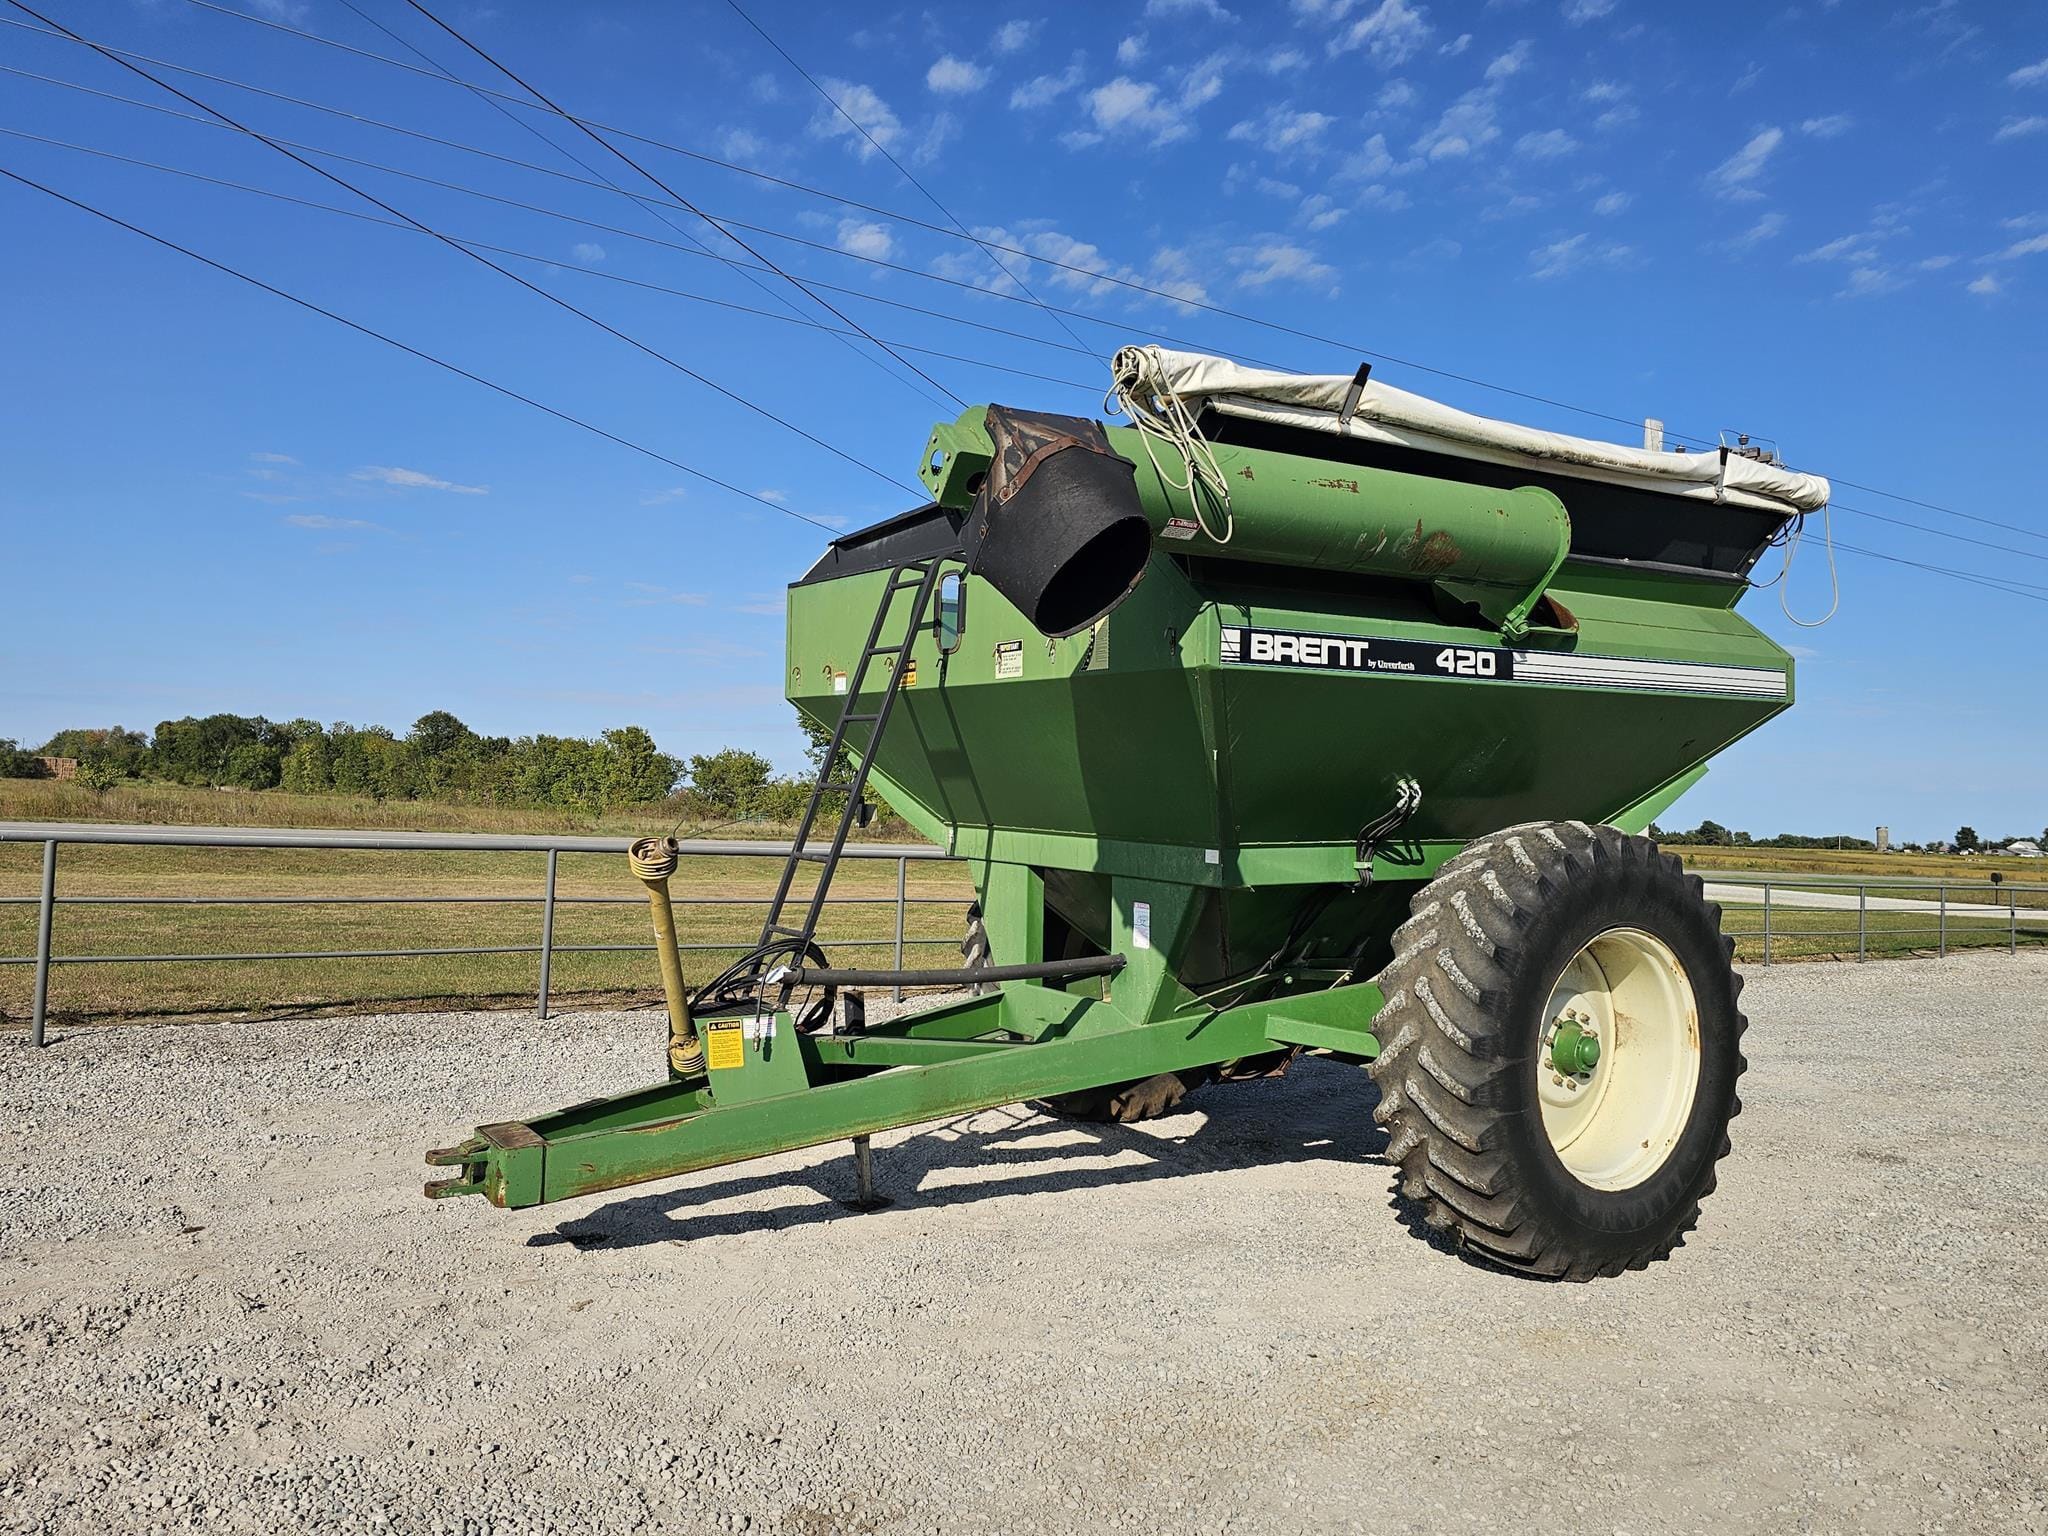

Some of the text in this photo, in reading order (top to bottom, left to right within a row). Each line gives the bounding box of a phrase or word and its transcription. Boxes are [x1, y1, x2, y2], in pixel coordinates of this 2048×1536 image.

[1250, 632, 1369, 667] BRENT
[1367, 658, 1377, 669] by
[1436, 648, 1496, 676] 420
[717, 1021, 740, 1029] CAUTION
